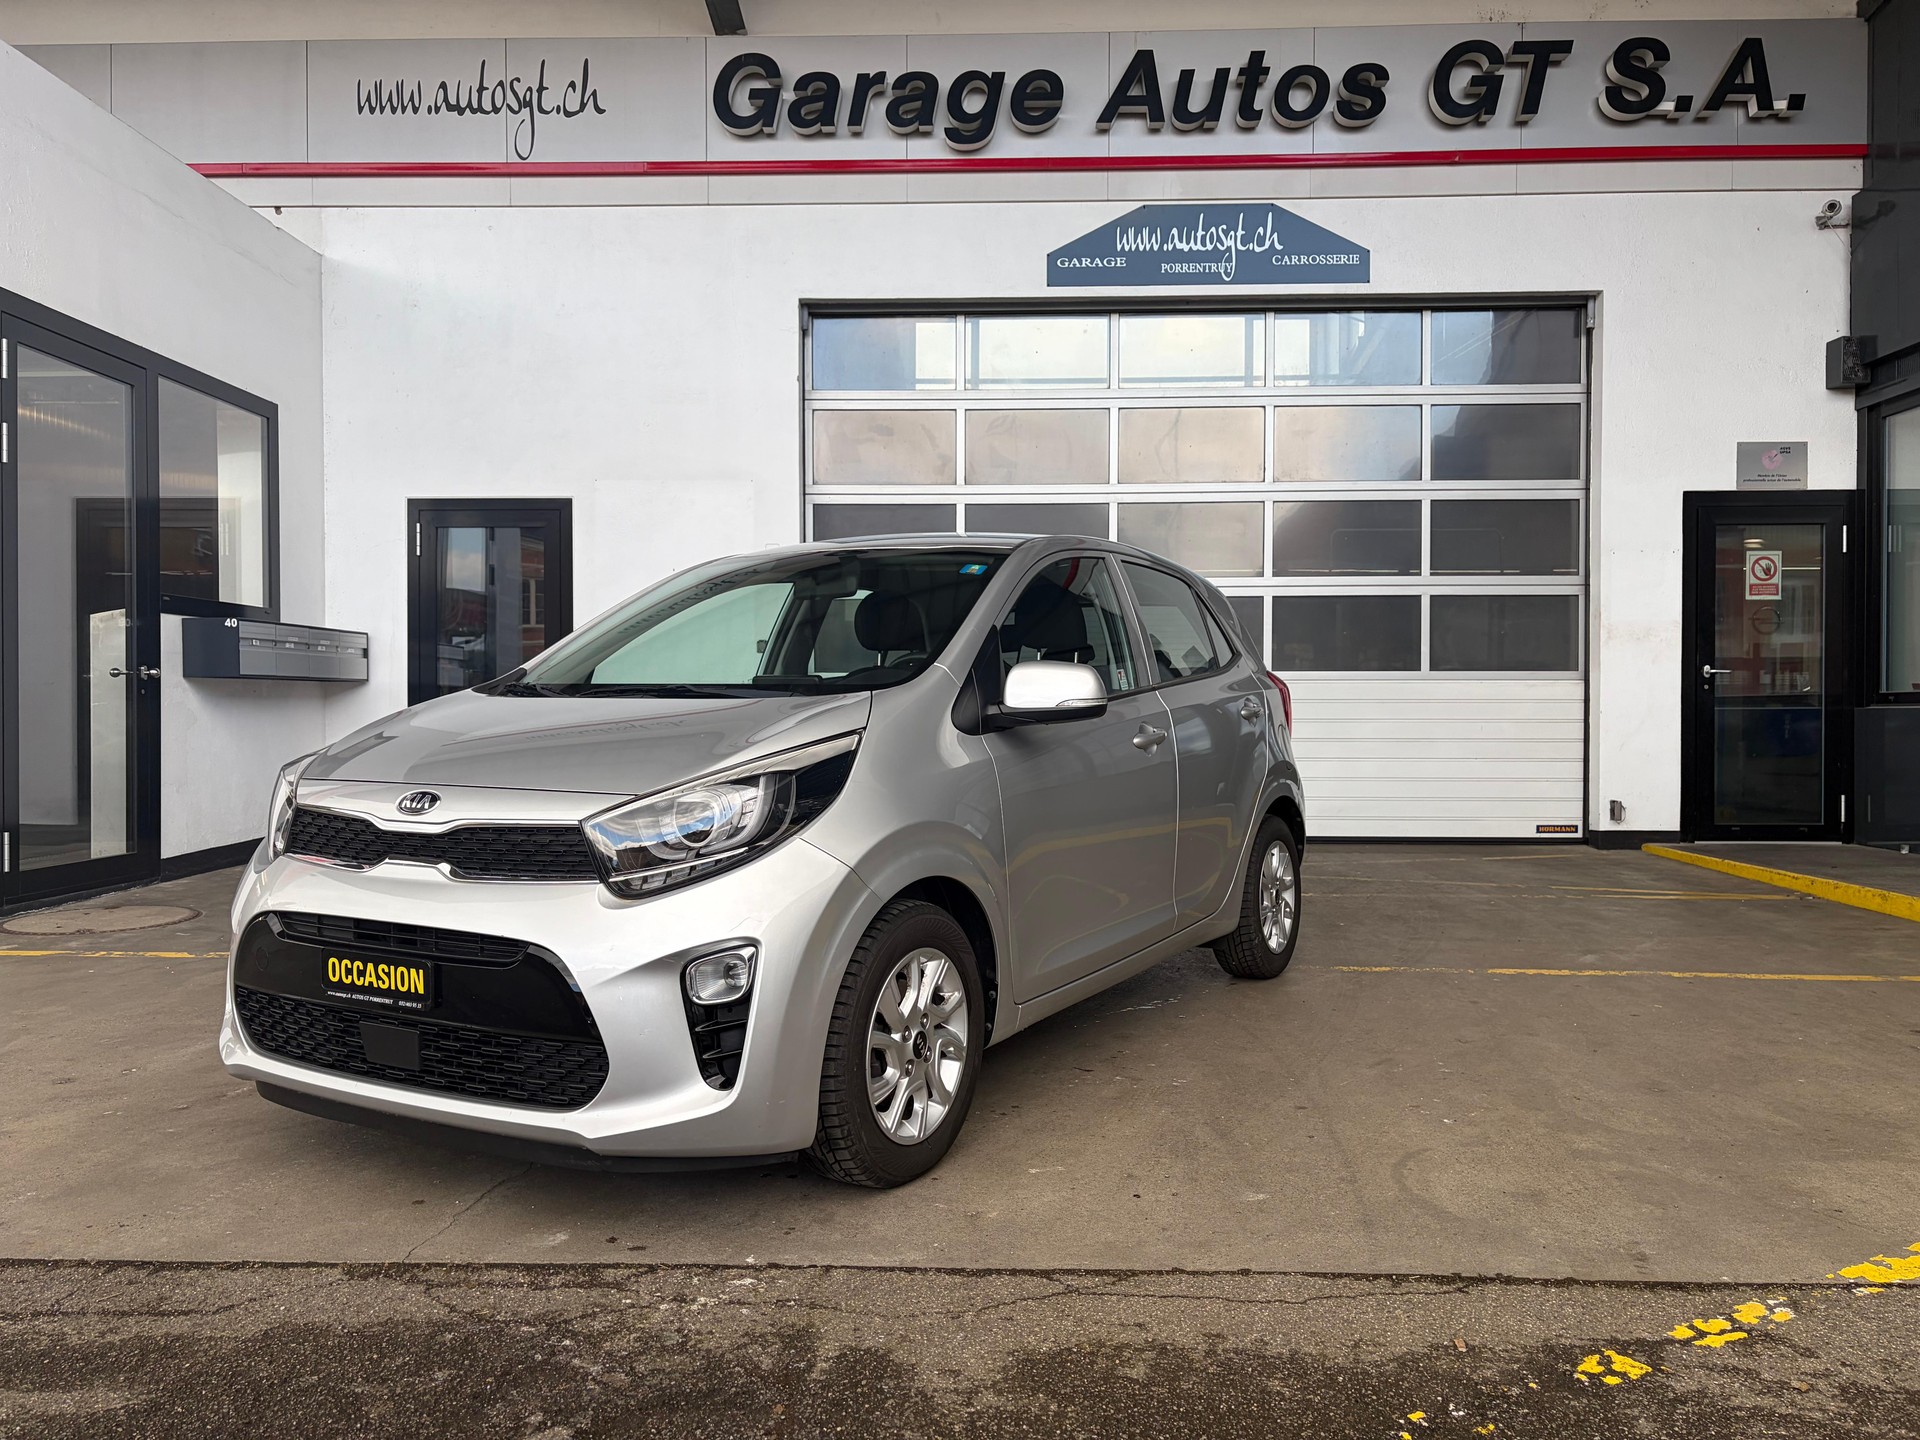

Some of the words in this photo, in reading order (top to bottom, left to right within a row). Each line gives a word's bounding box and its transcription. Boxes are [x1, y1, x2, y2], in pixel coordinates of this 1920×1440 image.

[713, 53, 1064, 152] Garage
[1096, 49, 1388, 129] Autos
[1429, 39, 1574, 124] GT
[1600, 37, 1807, 120] S.A.
[357, 58, 606, 160] www.autosgt.ch
[1116, 211, 1283, 281] www.autosgt.ch
[1057, 257, 1127, 268] GARAGE
[1161, 261, 1234, 273] PORRENTRUY
[1272, 254, 1360, 266] CARROSSERIE
[224, 618, 238, 627] 40
[401, 793, 432, 809] KIA
[328, 957, 425, 995] OCCASION
